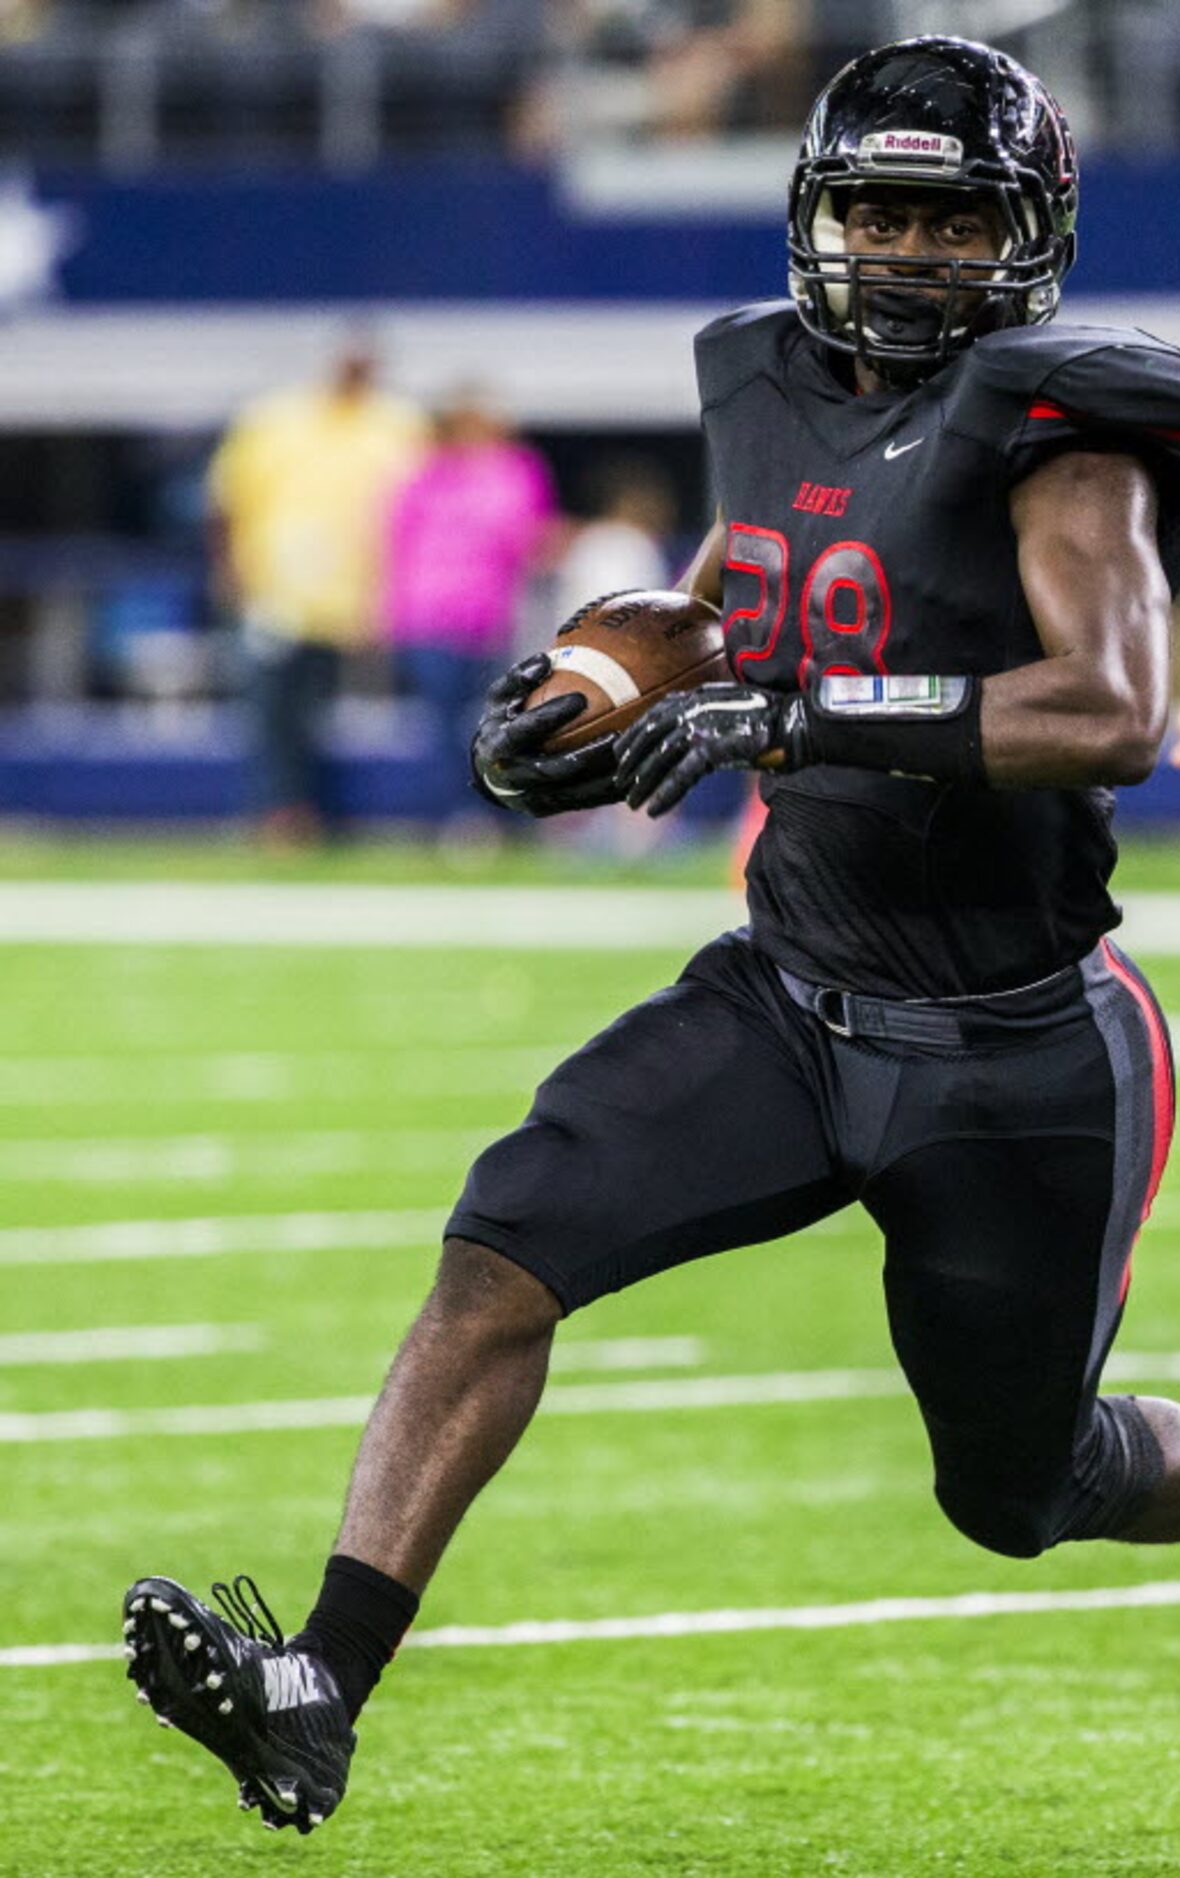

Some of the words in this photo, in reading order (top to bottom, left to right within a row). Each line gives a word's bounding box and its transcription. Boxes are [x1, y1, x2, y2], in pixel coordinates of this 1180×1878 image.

[884, 134, 941, 151] Riddell
[792, 482, 854, 517] HAWKS
[722, 522, 892, 690] 28
[262, 1653, 320, 1713] NIKE
